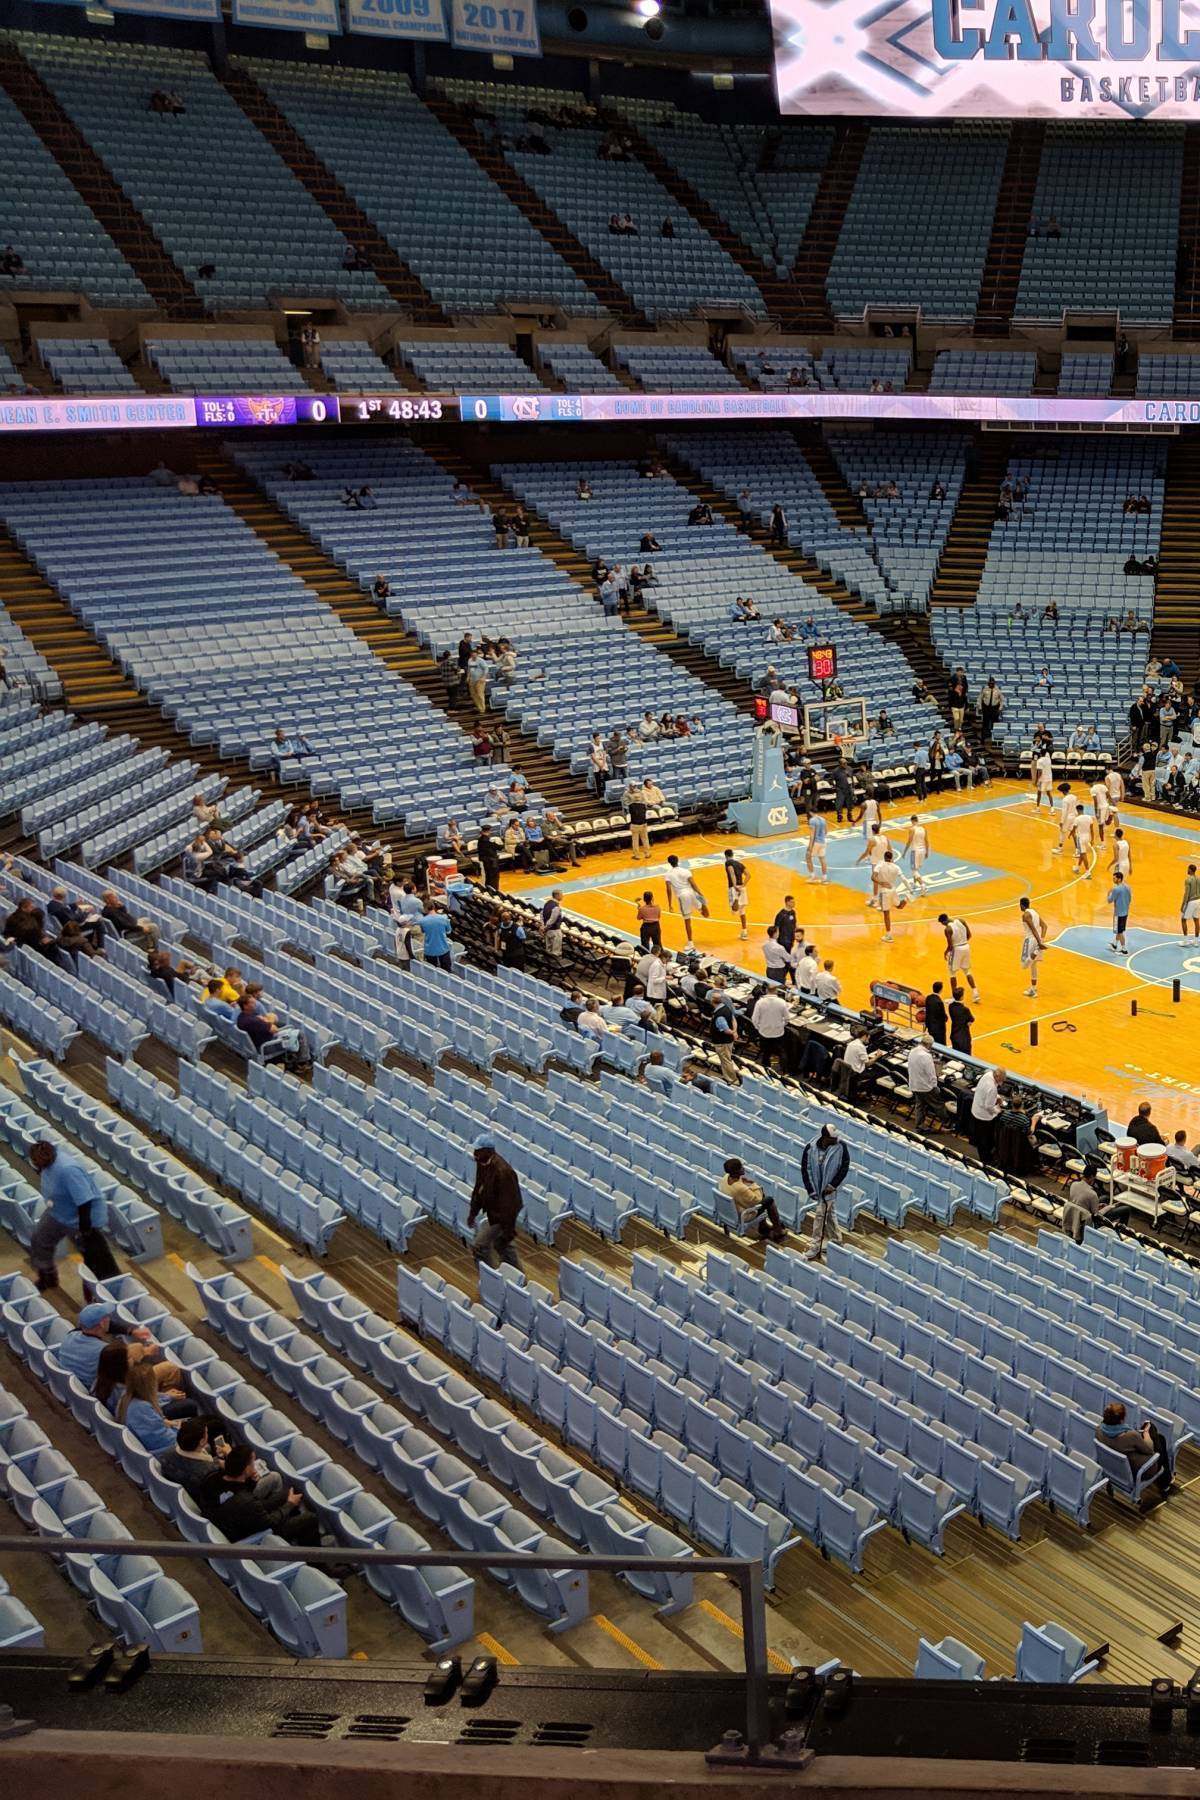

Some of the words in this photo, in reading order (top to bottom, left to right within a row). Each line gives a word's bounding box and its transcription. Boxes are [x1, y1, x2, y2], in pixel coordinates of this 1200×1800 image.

[463, 3, 526, 33] 2017
[66, 405, 120, 423] SMITH
[126, 403, 187, 422] CENTER
[228, 401, 235, 412] 4
[312, 400, 327, 421] 0
[358, 400, 383, 420] 1ST
[389, 399, 443, 420] 48:43
[475, 399, 487, 419] 0
[615, 399, 647, 415] HOME
[651, 400, 664, 414] OF
[667, 399, 721, 414] CAROLINA
[724, 398, 788, 414] BASKETBALL
